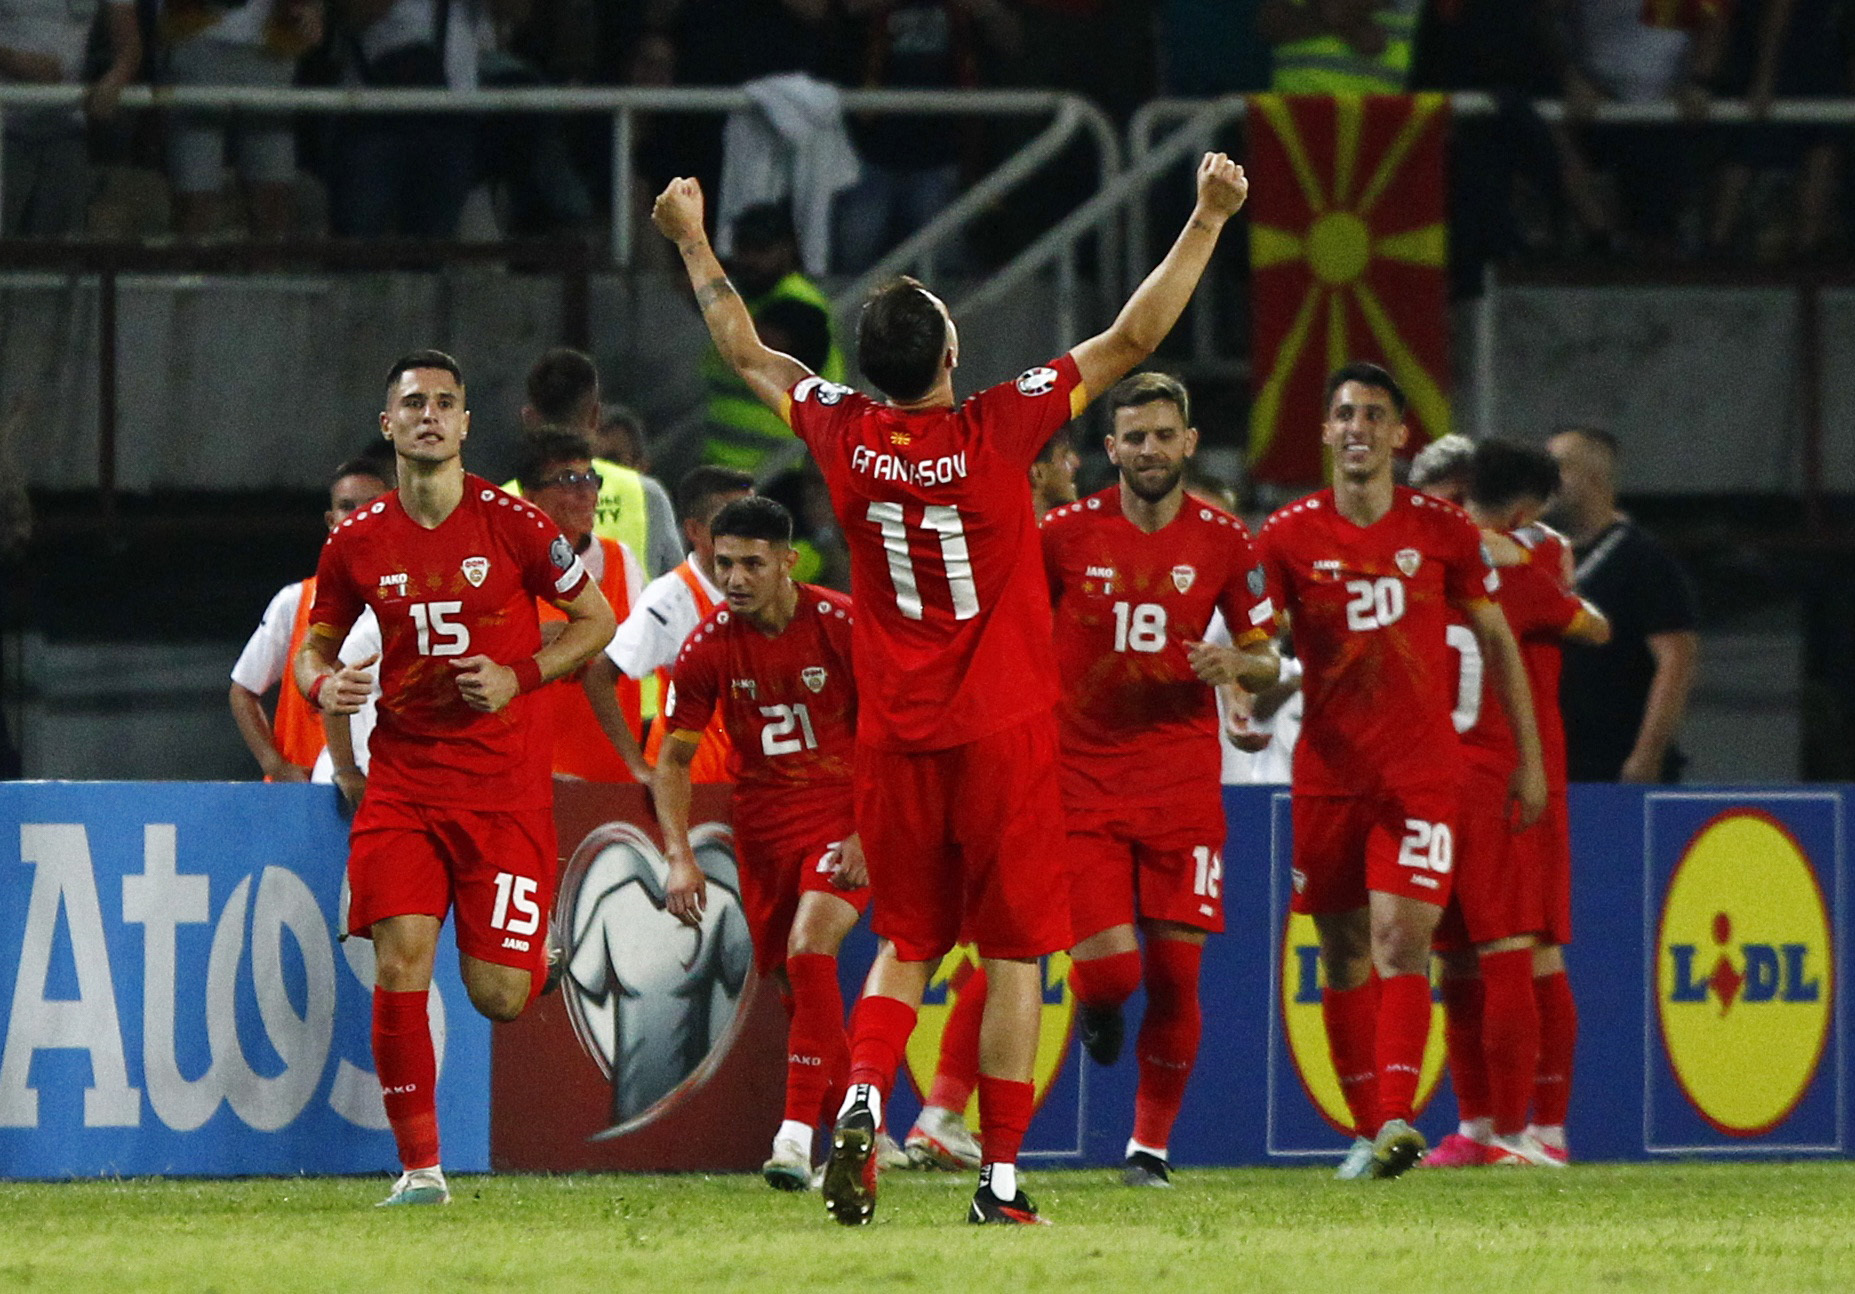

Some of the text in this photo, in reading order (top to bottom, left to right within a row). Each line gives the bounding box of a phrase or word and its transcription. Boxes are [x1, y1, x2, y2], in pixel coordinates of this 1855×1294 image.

[379, 573, 408, 587] JAKO
[866, 501, 980, 620] 11
[1085, 565, 1113, 578] JAKO
[409, 601, 470, 656] 15
[1112, 602, 1167, 652] 18
[1345, 577, 1405, 632] 20
[759, 704, 818, 756] 21
[1398, 819, 1453, 874] 20
[490, 872, 540, 936] 15
[501, 937, 530, 952] JAKO
[382, 1083, 416, 1095] AKO
